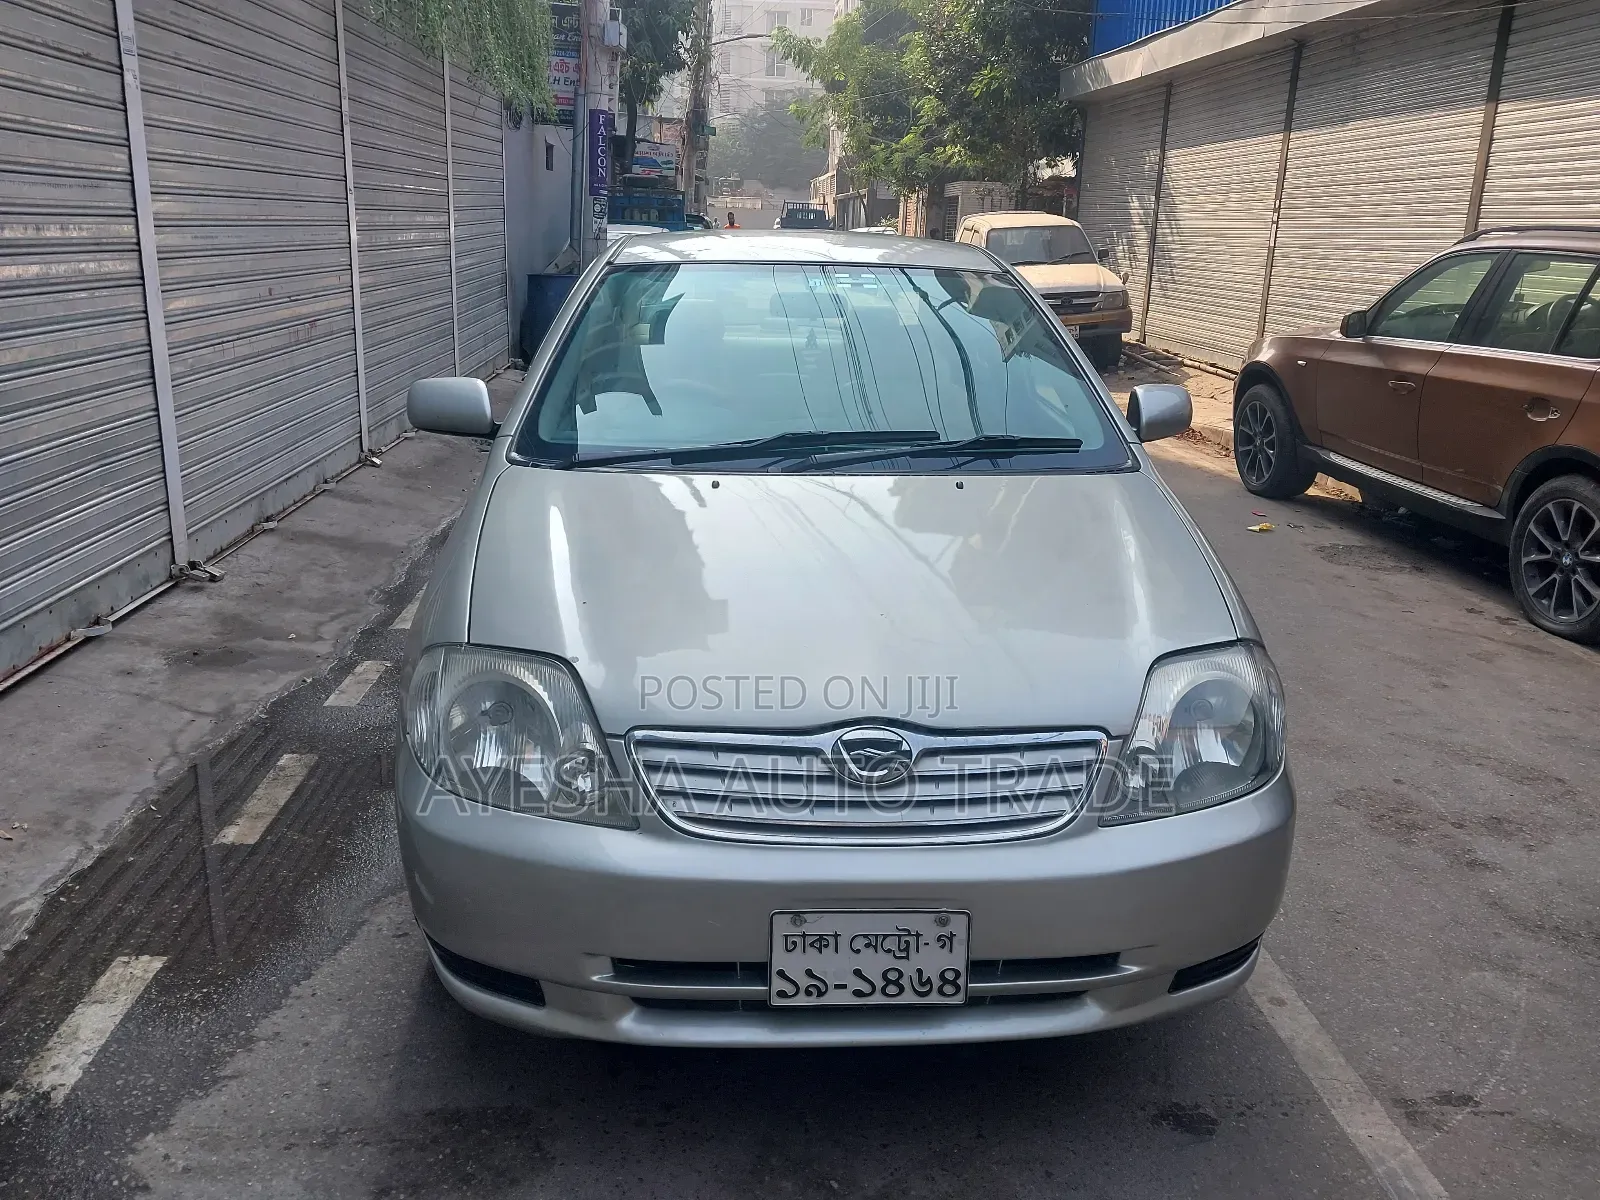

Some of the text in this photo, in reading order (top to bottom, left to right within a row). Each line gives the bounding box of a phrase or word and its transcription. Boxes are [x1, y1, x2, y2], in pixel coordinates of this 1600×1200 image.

[597, 114, 607, 178] FALCON
[782, 930, 842, 955] ঢাকা
[775, 966, 963, 999] ১৯-১৪৬৪
